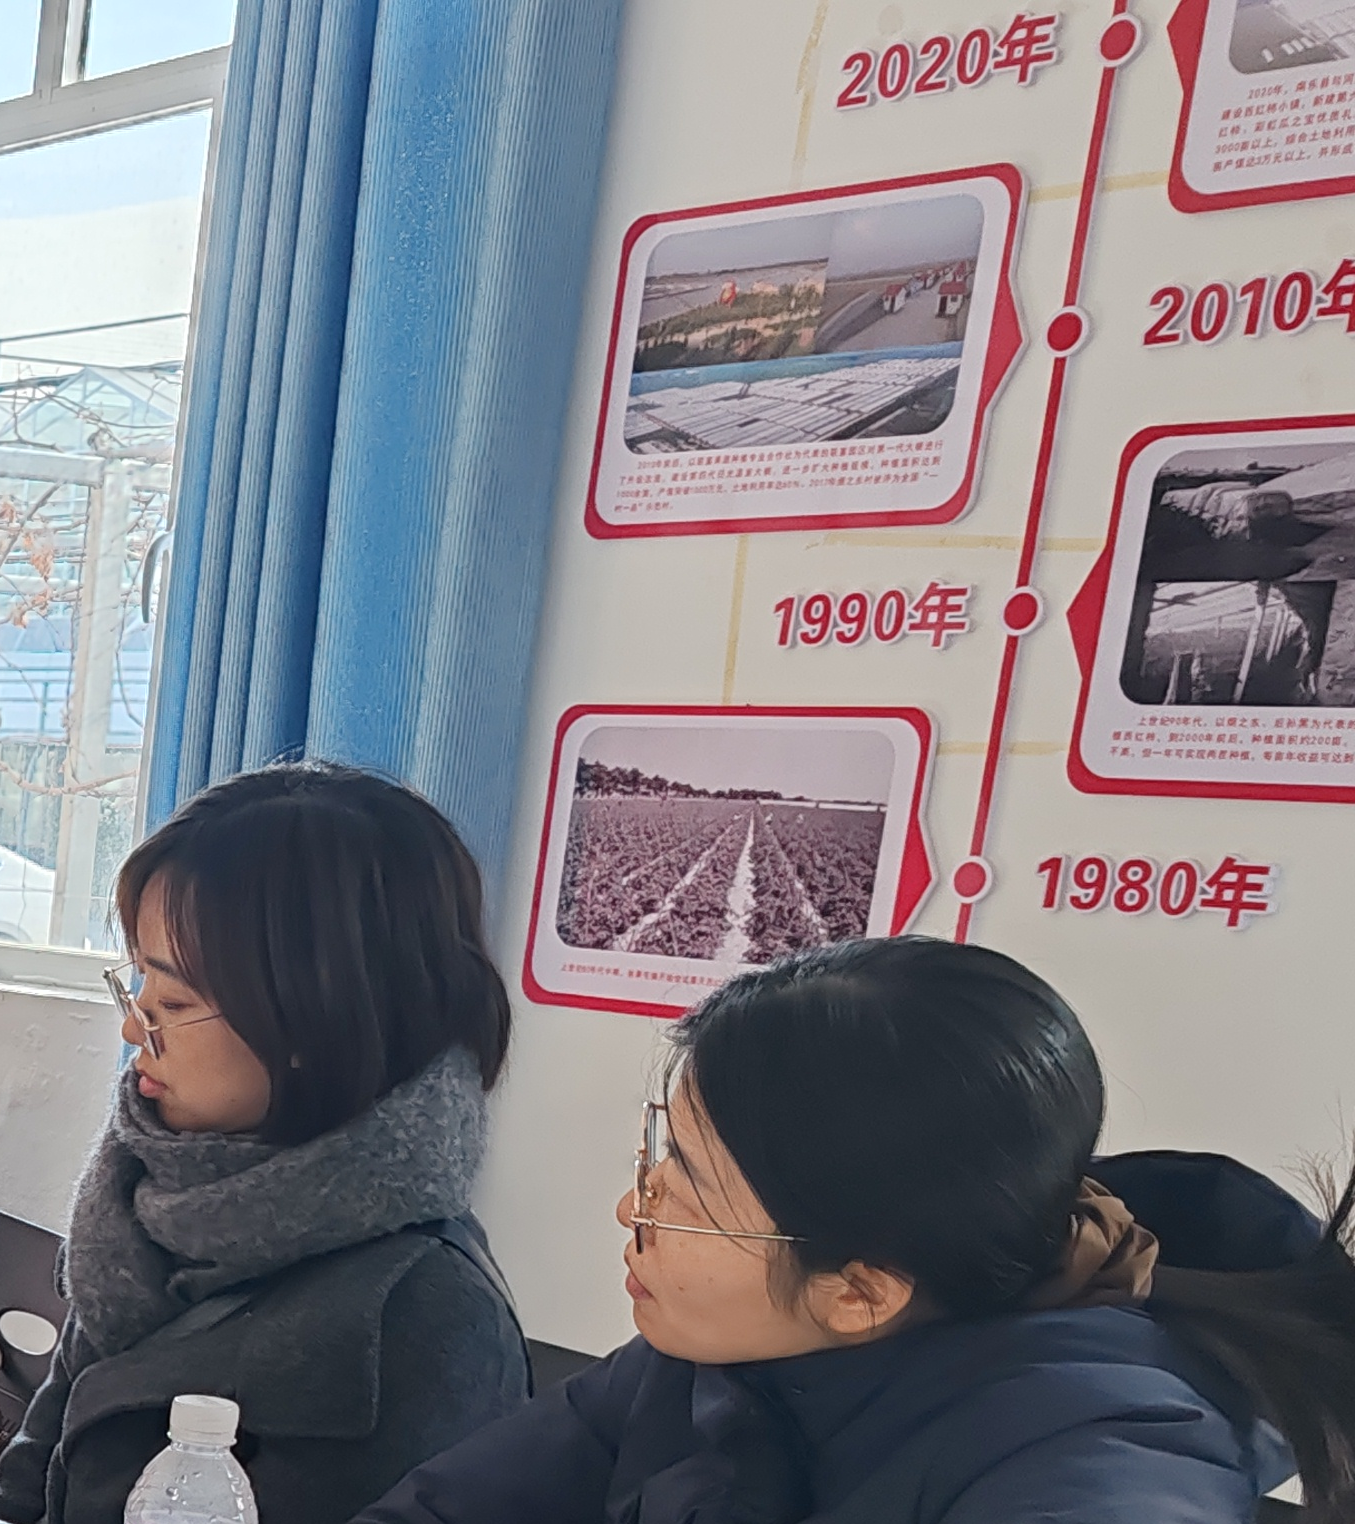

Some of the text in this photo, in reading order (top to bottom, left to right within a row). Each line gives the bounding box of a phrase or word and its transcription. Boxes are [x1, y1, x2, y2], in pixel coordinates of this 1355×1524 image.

[835, 13, 1056, 109] 2020年
[1142, 258, 1355, 347] 2010年
[773, 581, 969, 648] 1990年
[1037, 855, 1271, 929] 1980年
